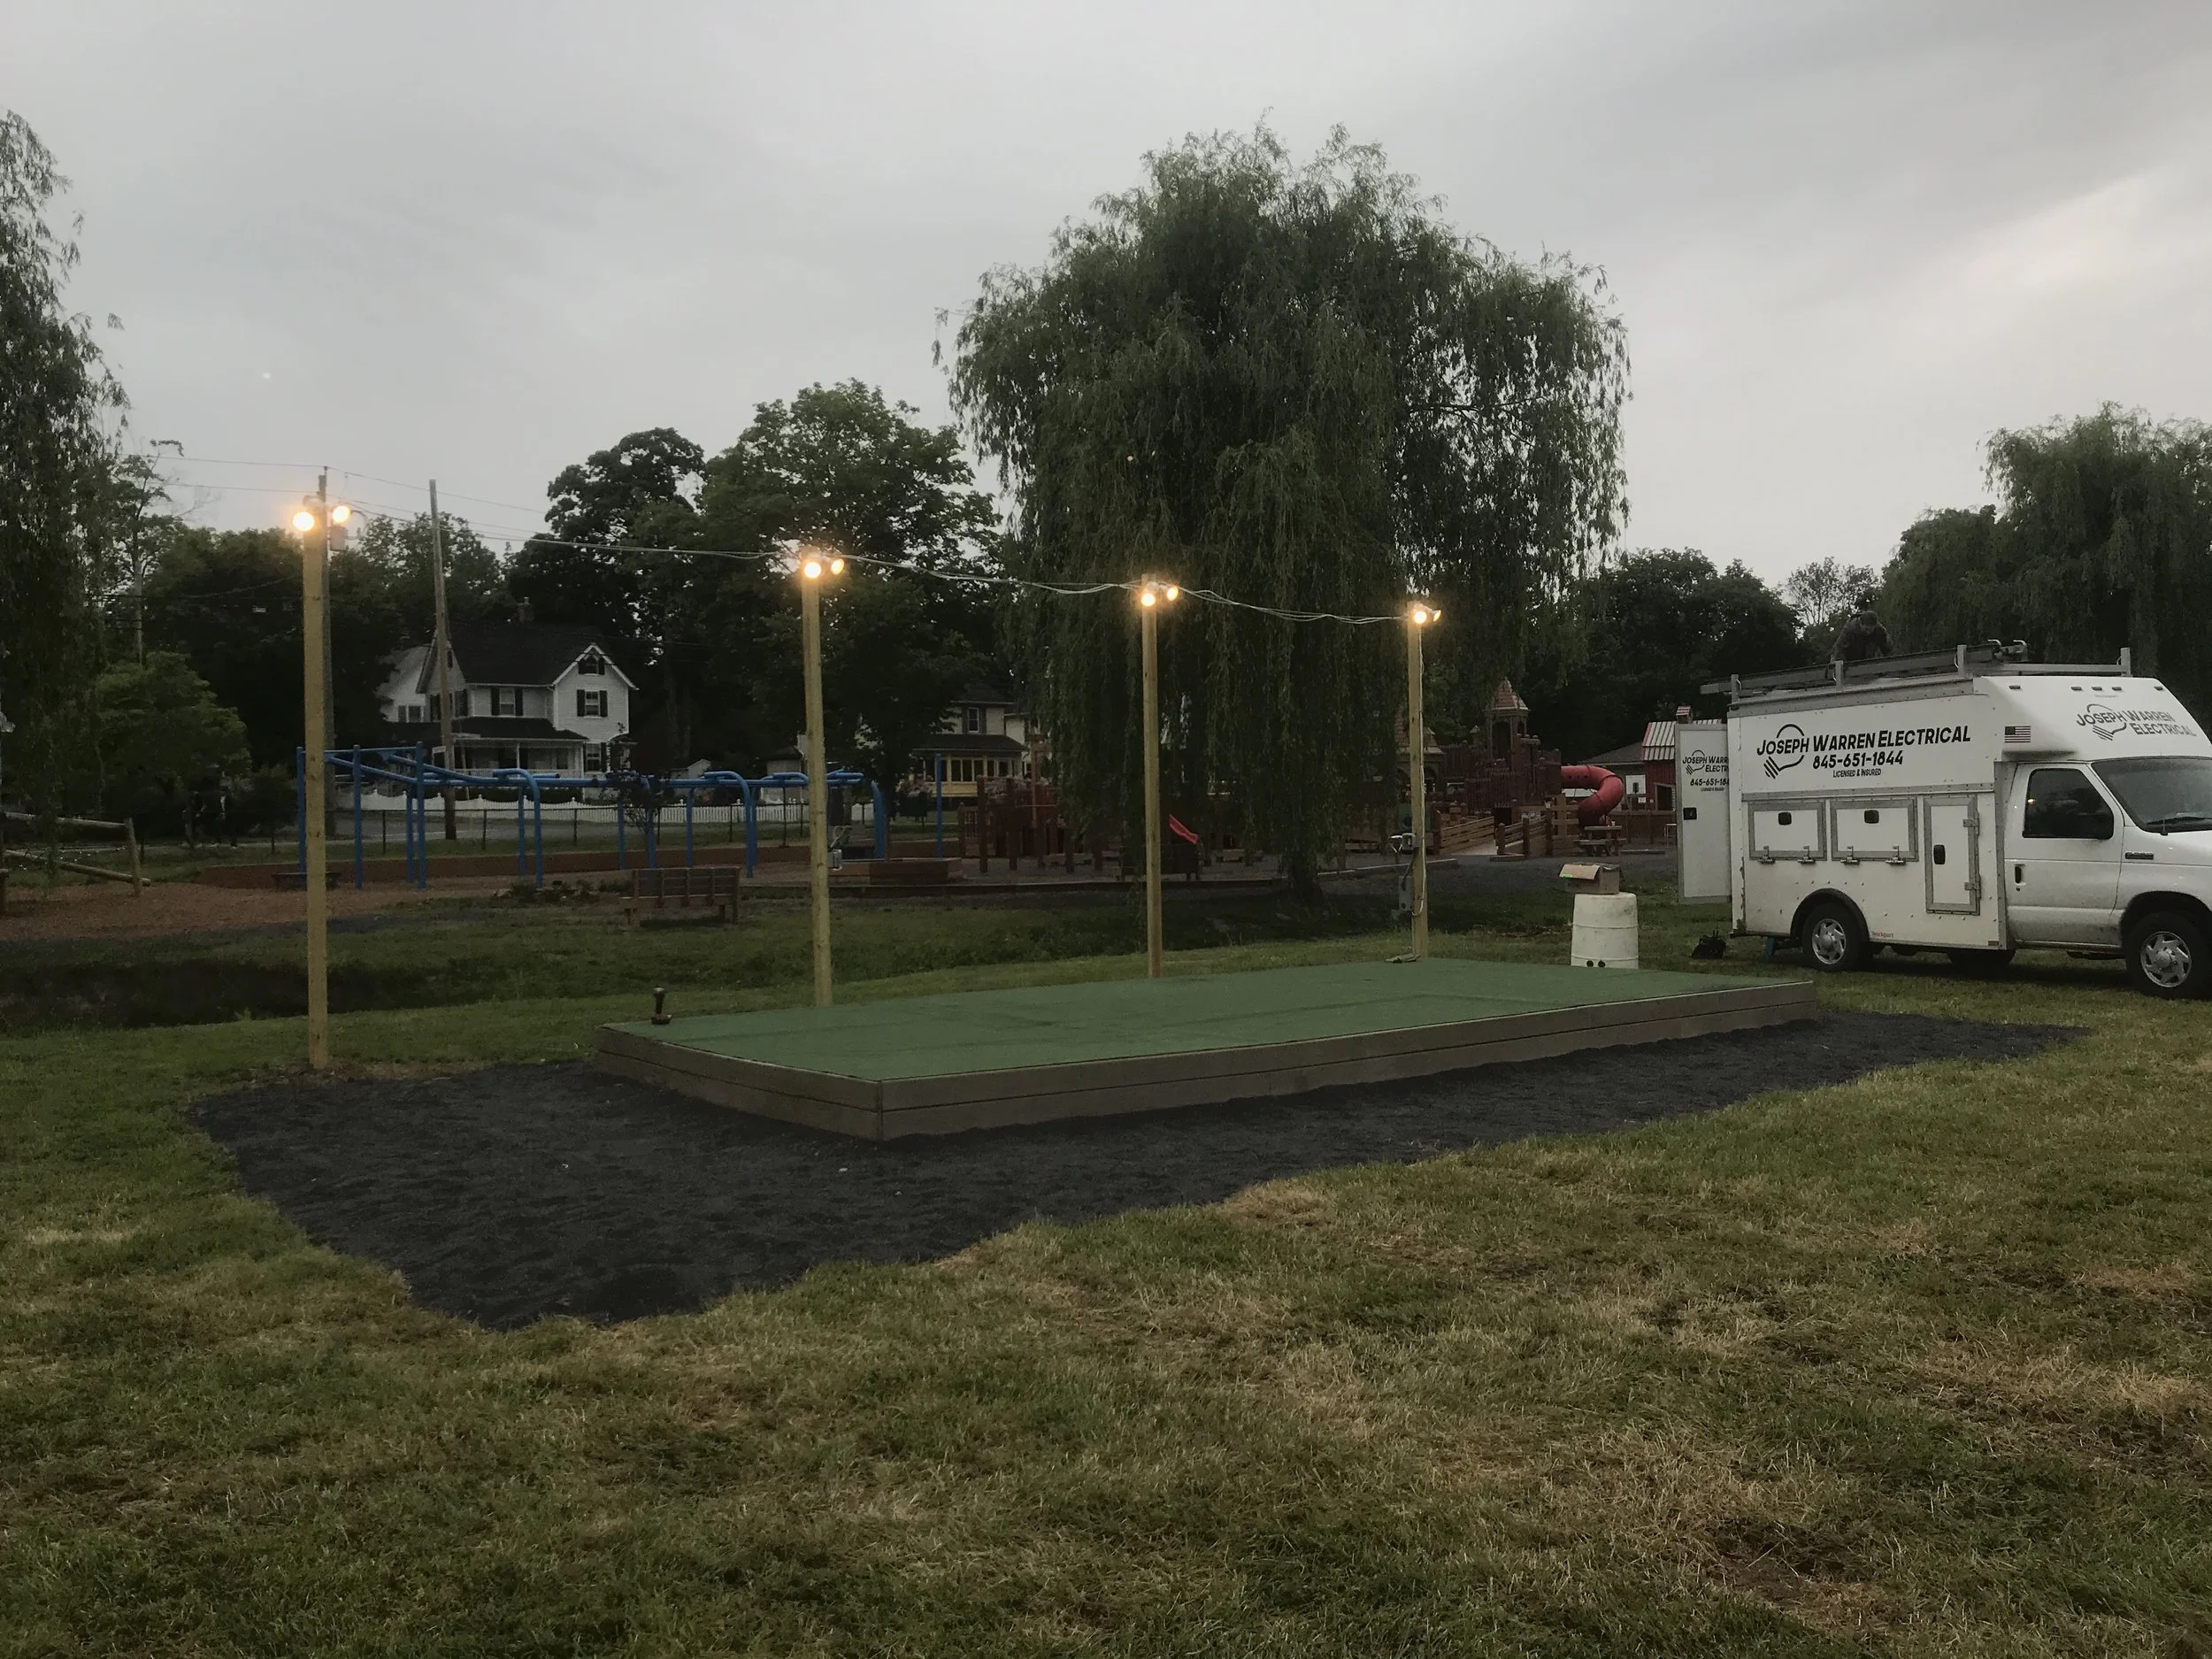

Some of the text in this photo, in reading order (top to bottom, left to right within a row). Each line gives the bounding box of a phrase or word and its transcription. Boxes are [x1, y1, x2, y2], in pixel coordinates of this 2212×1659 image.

[2077, 710, 2176, 726] JOSEPH WARREN
[2129, 722, 2197, 737] ELECTRICAL
[1756, 725, 1971, 757] JOSEPH WARREN ELECTRICAL
[1812, 749, 1903, 770] 845-651-1844
[1832, 769, 1856, 778] LICENSED
